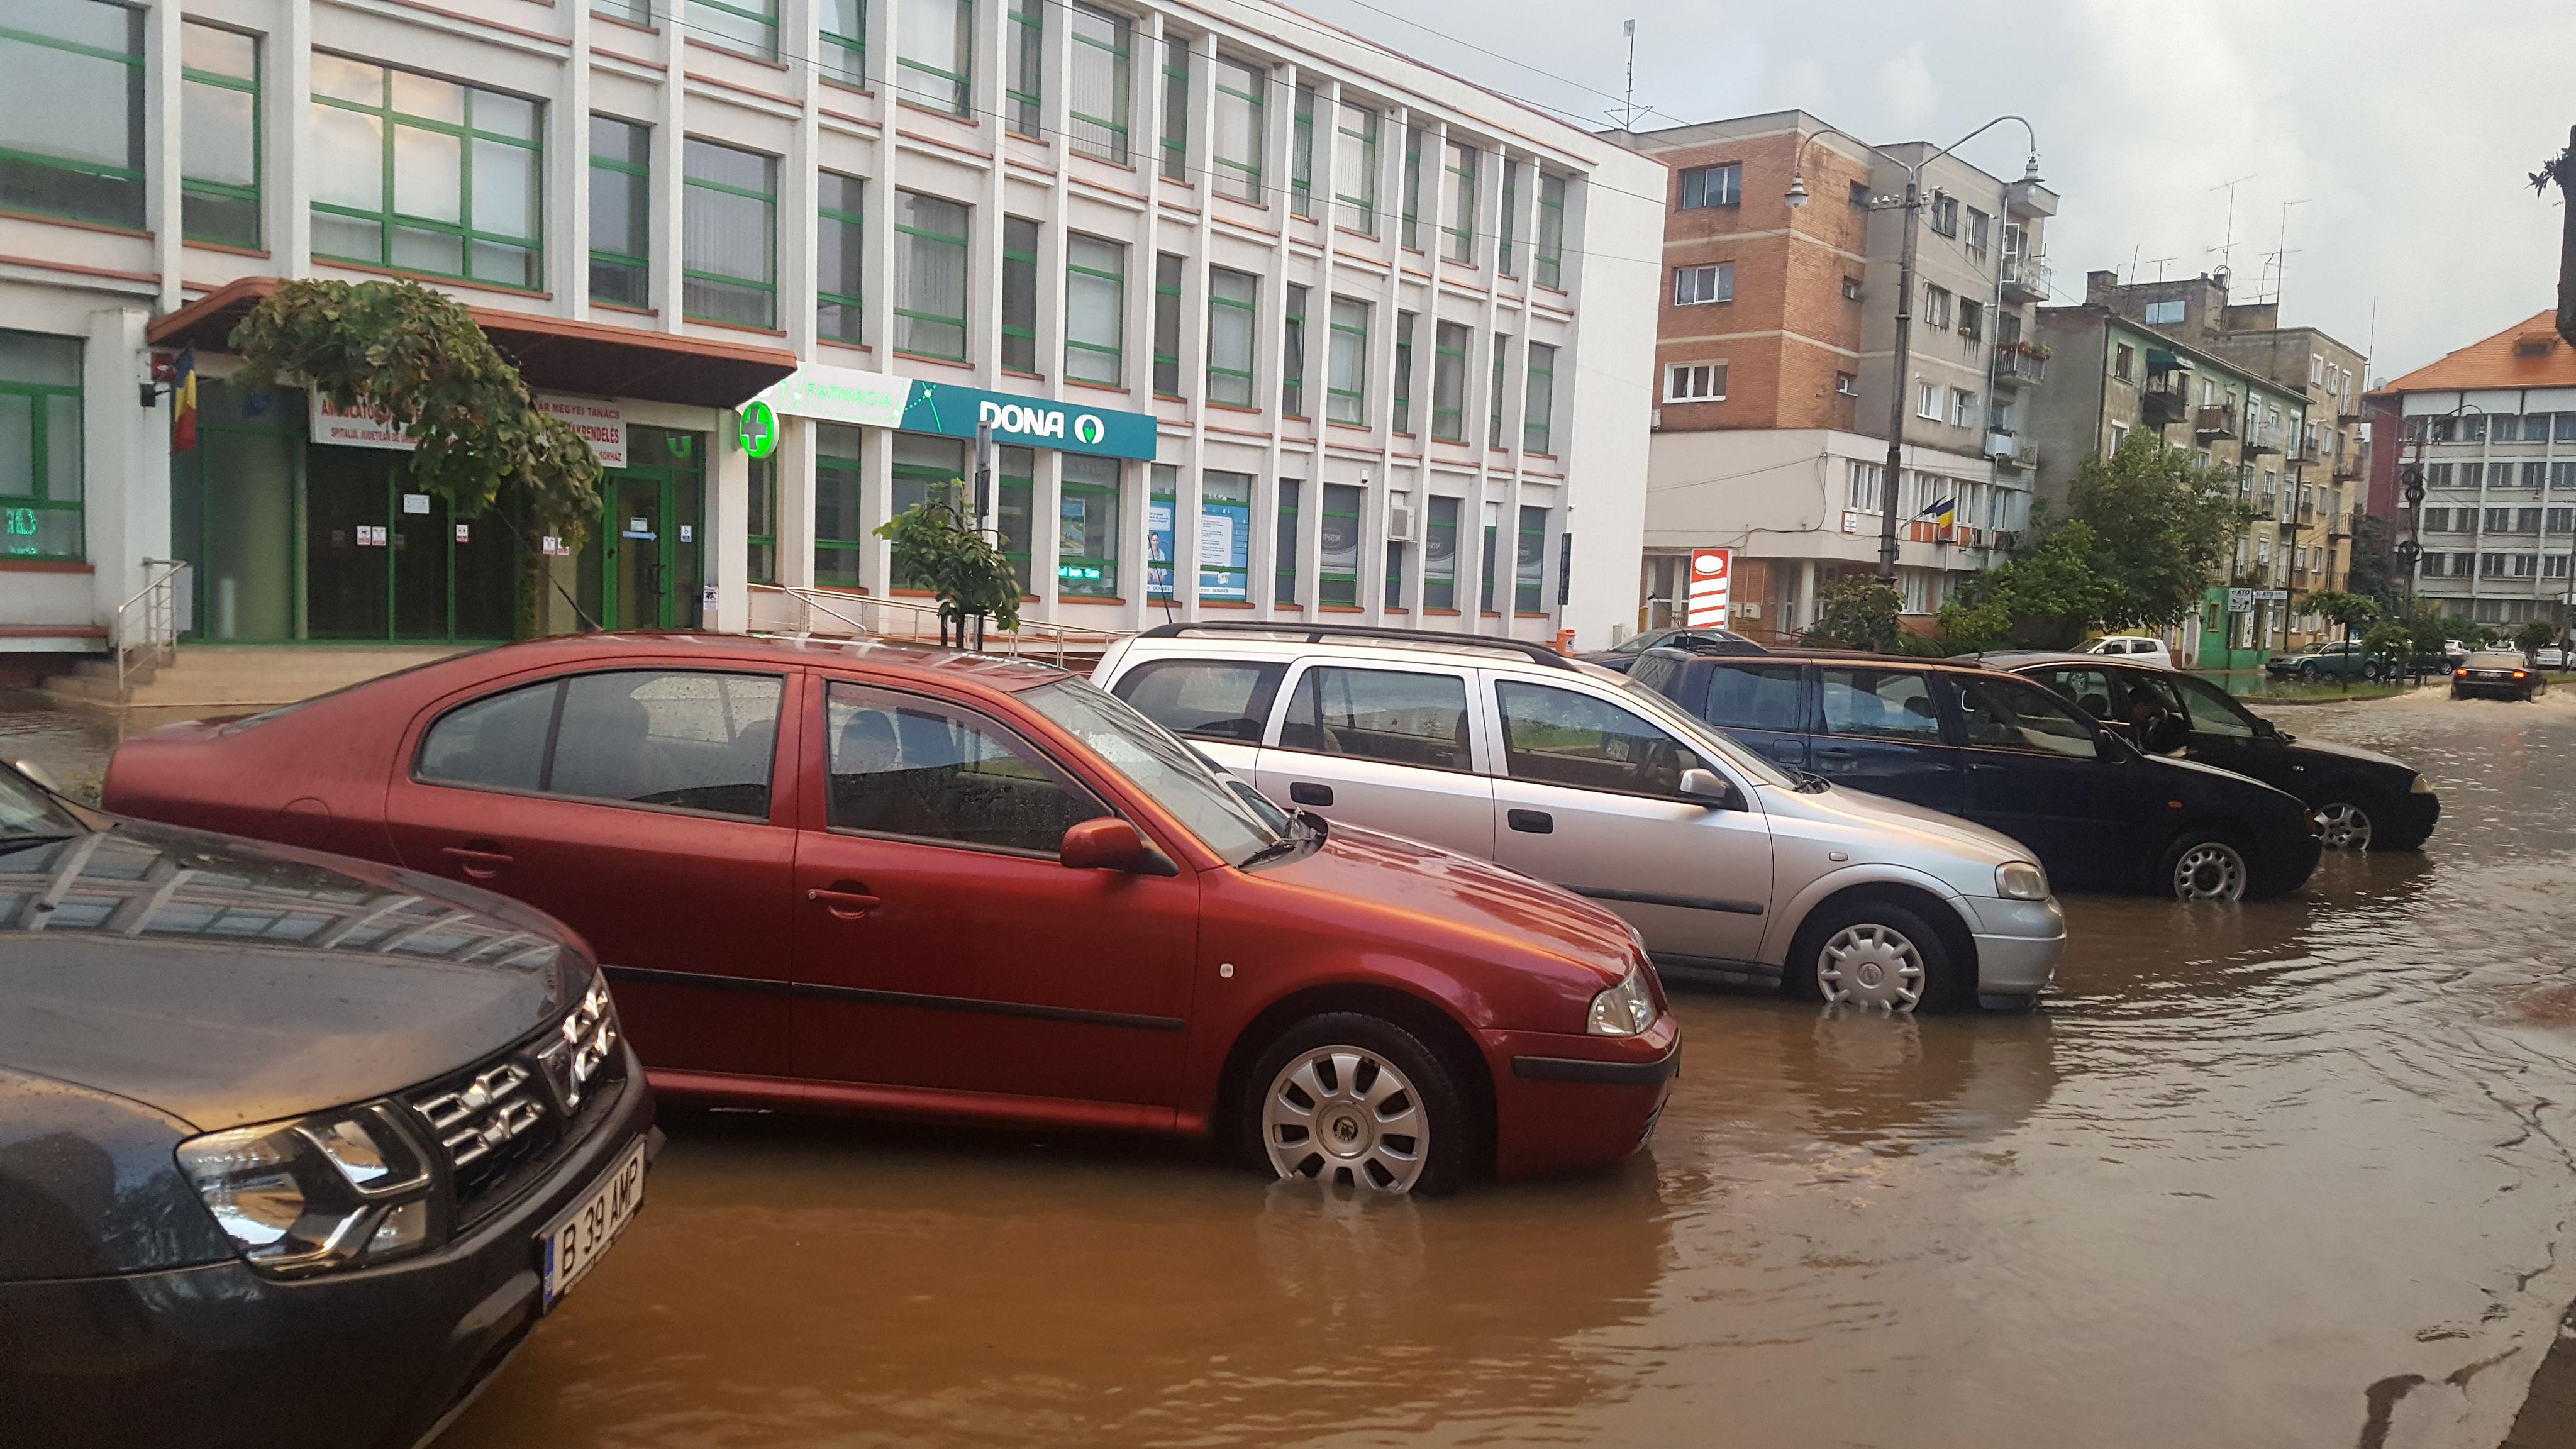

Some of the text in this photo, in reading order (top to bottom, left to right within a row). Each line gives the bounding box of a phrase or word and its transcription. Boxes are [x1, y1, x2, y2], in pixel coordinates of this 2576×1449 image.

[552, 403, 585, 416] MEGYEI
[806, 382, 893, 408] FARMACIA
[980, 401, 1065, 439] DONA
[562, 1223, 576, 1278] B
[584, 1195, 604, 1255] 39
[609, 1157, 638, 1227] AMP
